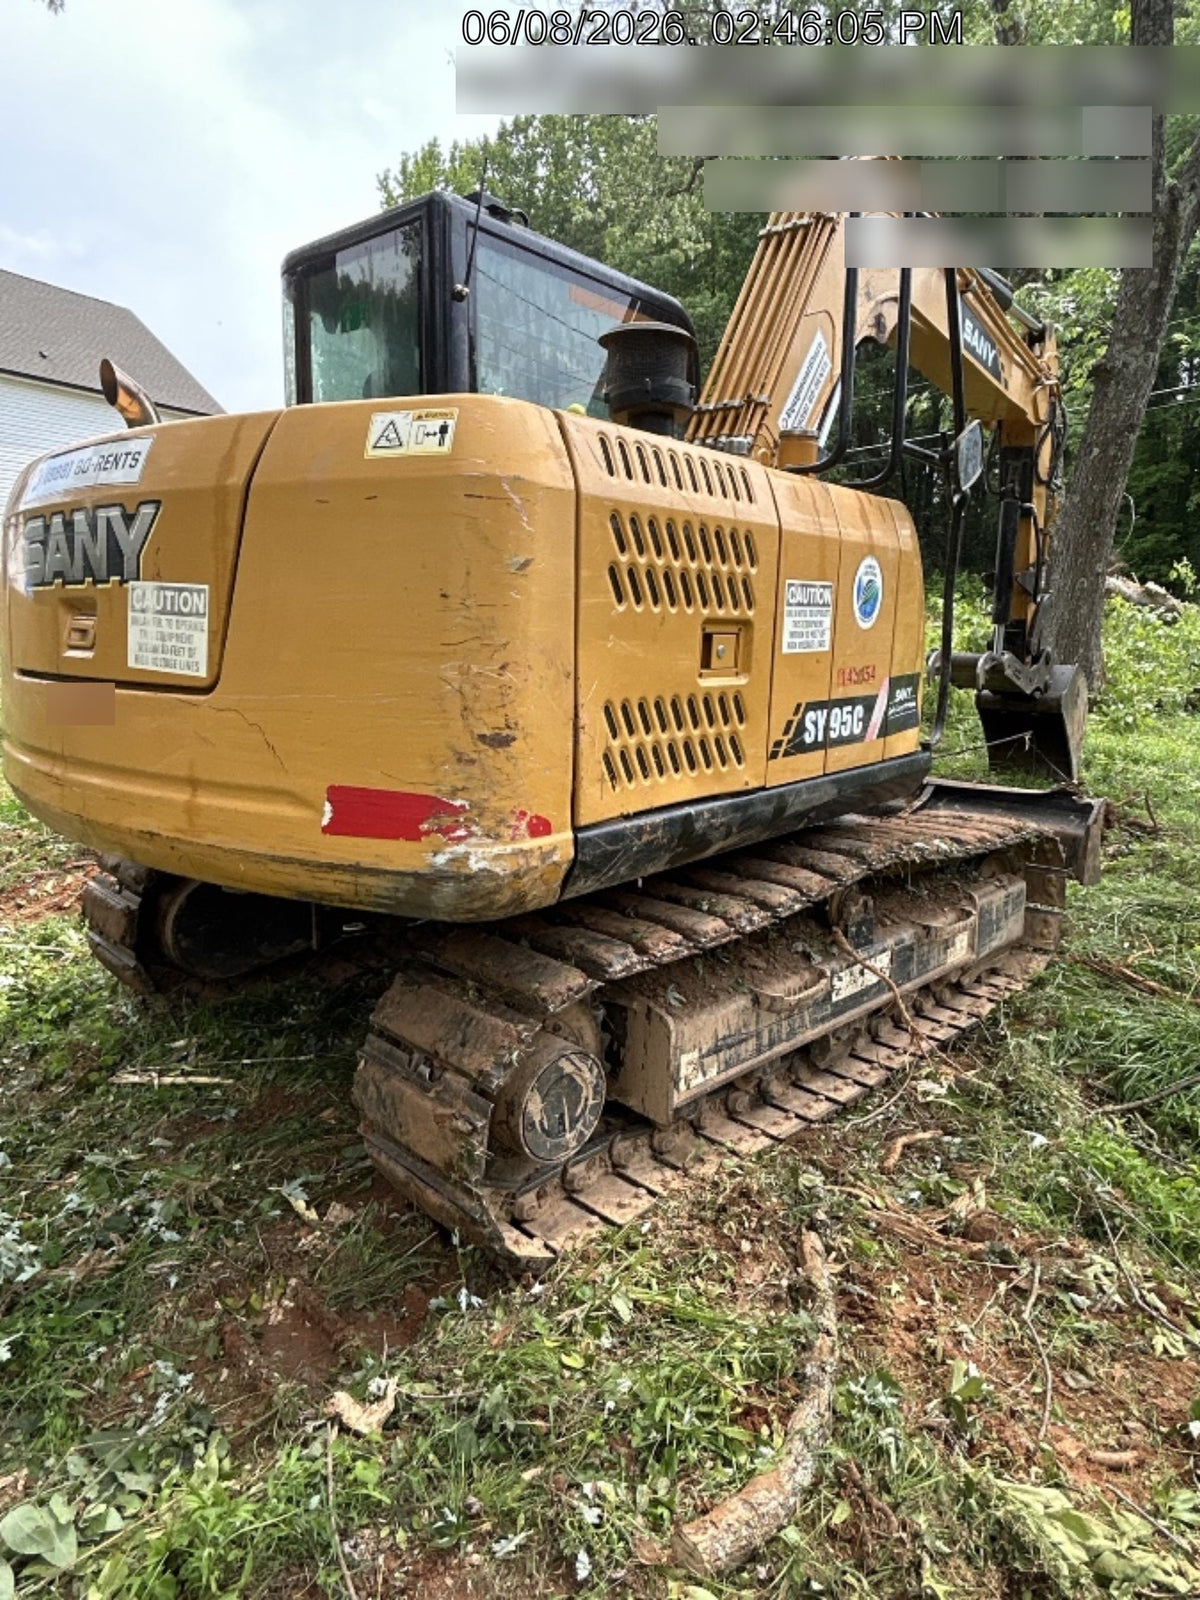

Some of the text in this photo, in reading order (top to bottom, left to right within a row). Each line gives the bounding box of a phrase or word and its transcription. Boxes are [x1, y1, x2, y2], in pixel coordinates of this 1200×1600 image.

[963, 318, 997, 367] SANY
[24, 499, 162, 588] SANY
[132, 588, 205, 614] CAUTION
[788, 586, 831, 605] CAUTION
